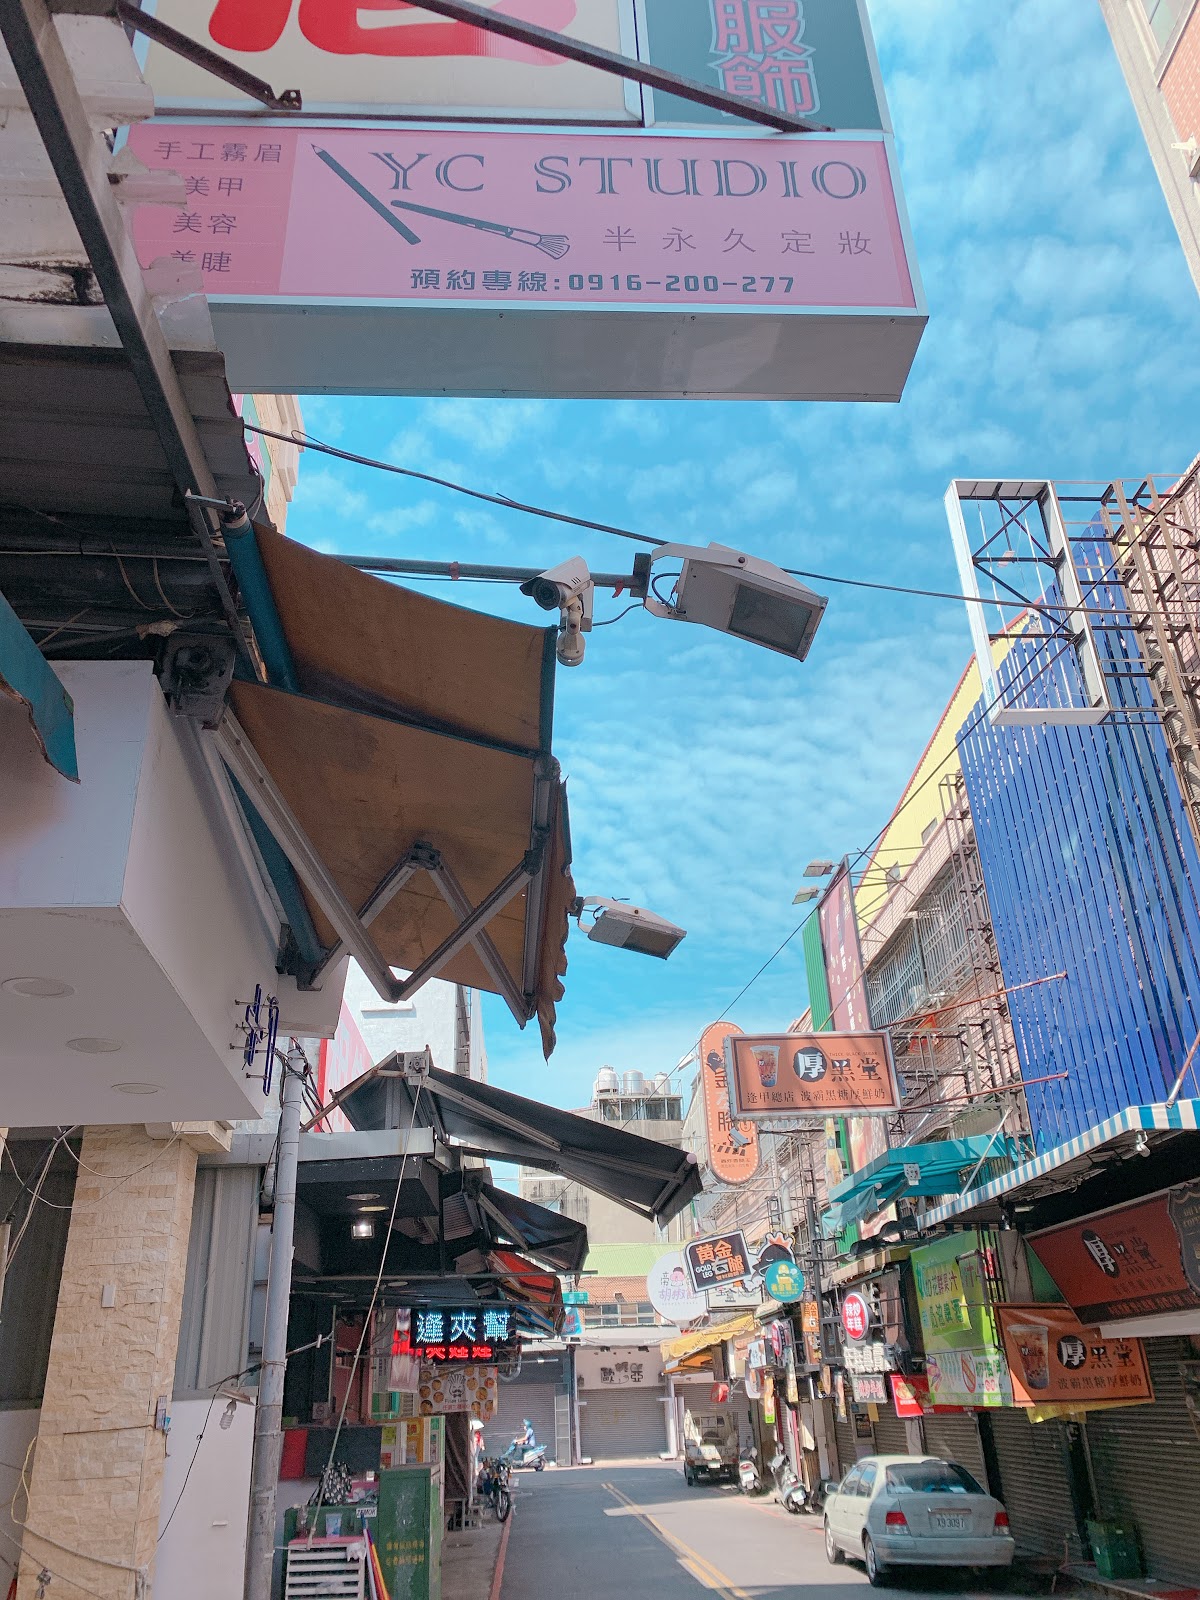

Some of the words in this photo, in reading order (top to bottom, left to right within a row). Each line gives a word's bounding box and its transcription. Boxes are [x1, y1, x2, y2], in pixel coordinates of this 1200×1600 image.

[154, 141, 282, 163] 手工霧眉
[185, 175, 243, 196] 美甲
[368, 152, 485, 192] YC
[534, 156, 867, 199] STUDIO
[173, 212, 237, 234] 美容
[603, 226, 873, 256] 半永久定妝
[410, 269, 795, 293] 預約專線:0916-200-277
[798, 1052, 882, 1082] 厚黑堂
[695, 1264, 712, 1273] GOLD
[702, 1271, 714, 1279] LEG
[1062, 1342, 1135, 1369] 厚黑堂
